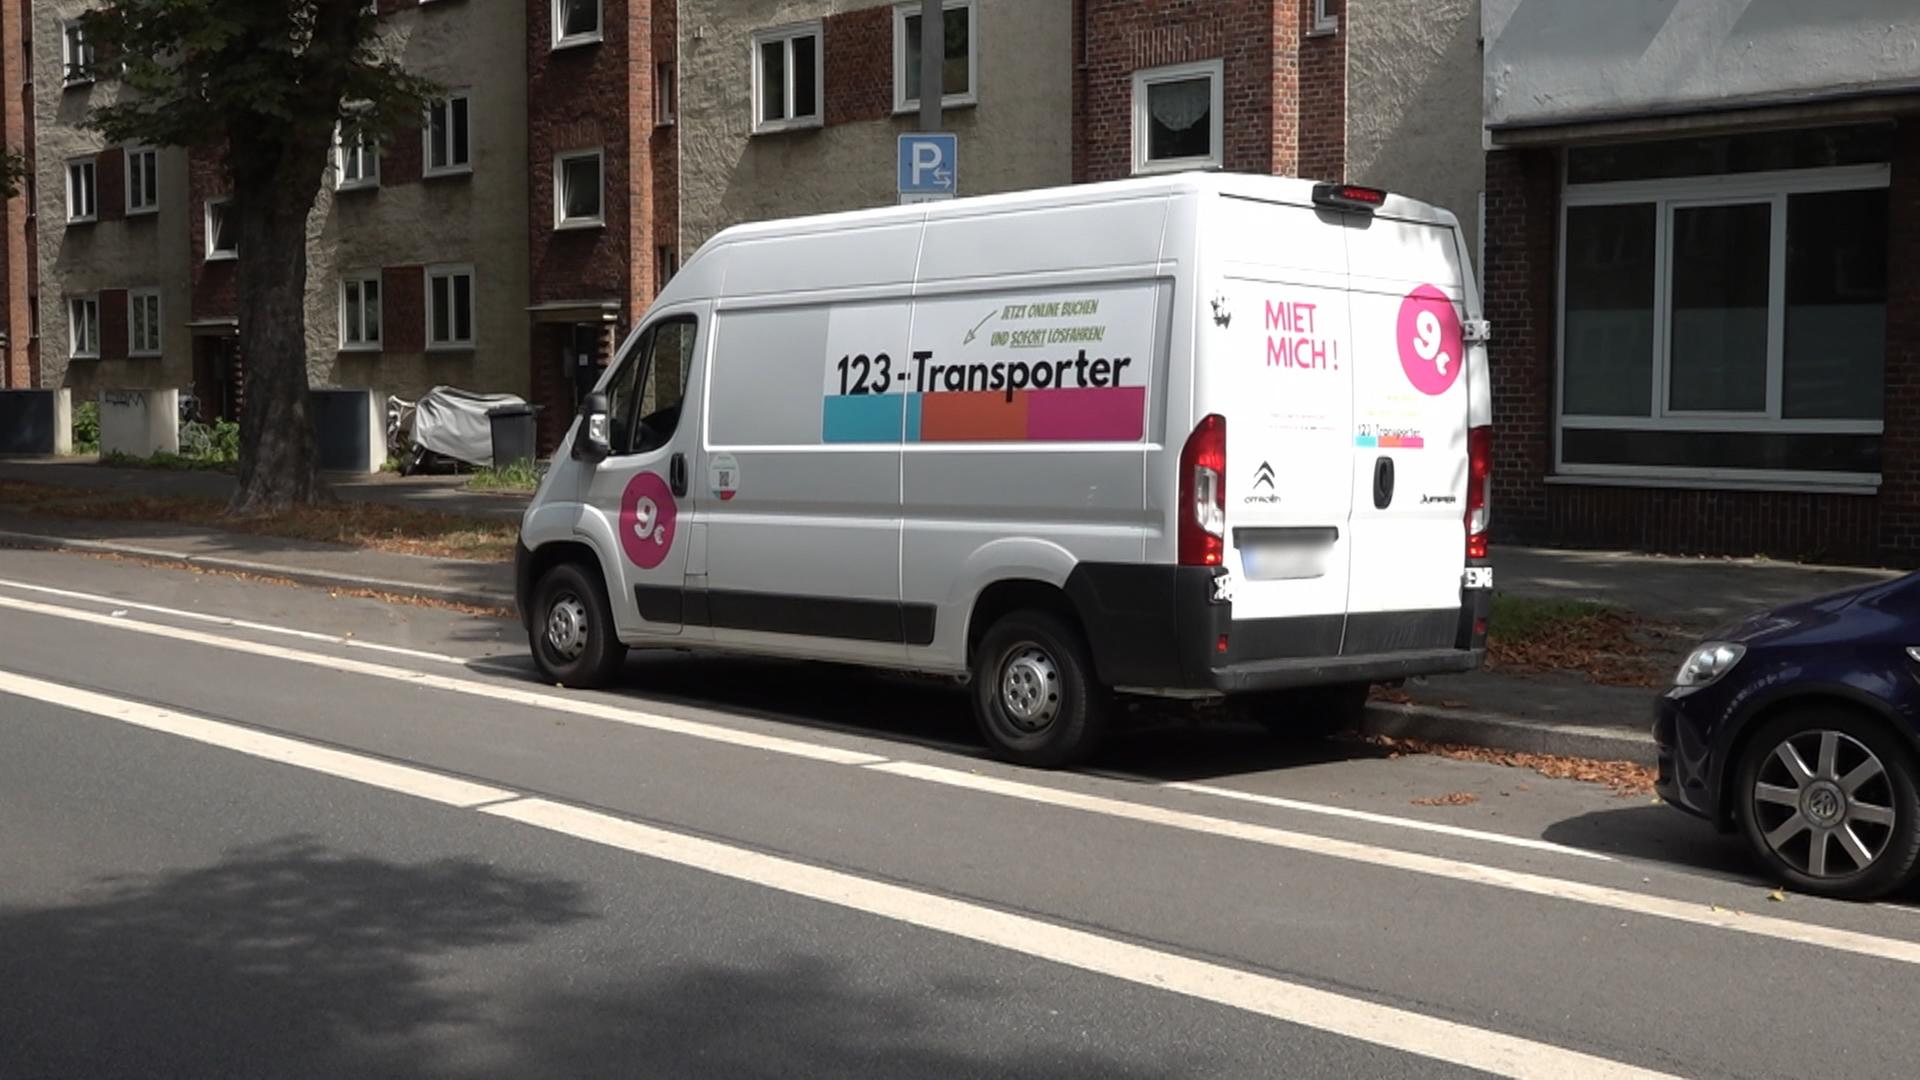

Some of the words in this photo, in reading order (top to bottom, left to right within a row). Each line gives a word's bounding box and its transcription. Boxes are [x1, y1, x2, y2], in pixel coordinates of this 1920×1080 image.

[912, 141, 942, 185] P
[1001, 304, 1027, 320] JETZT
[1028, 302, 1060, 318] ONLINE
[1060, 298, 1099, 316] BUCHEN
[1265, 299, 1316, 333] MIET
[990, 331, 1010, 346] UND
[1010, 328, 1047, 346] SOFORT
[1047, 325, 1105, 344] LOSFAHREN!
